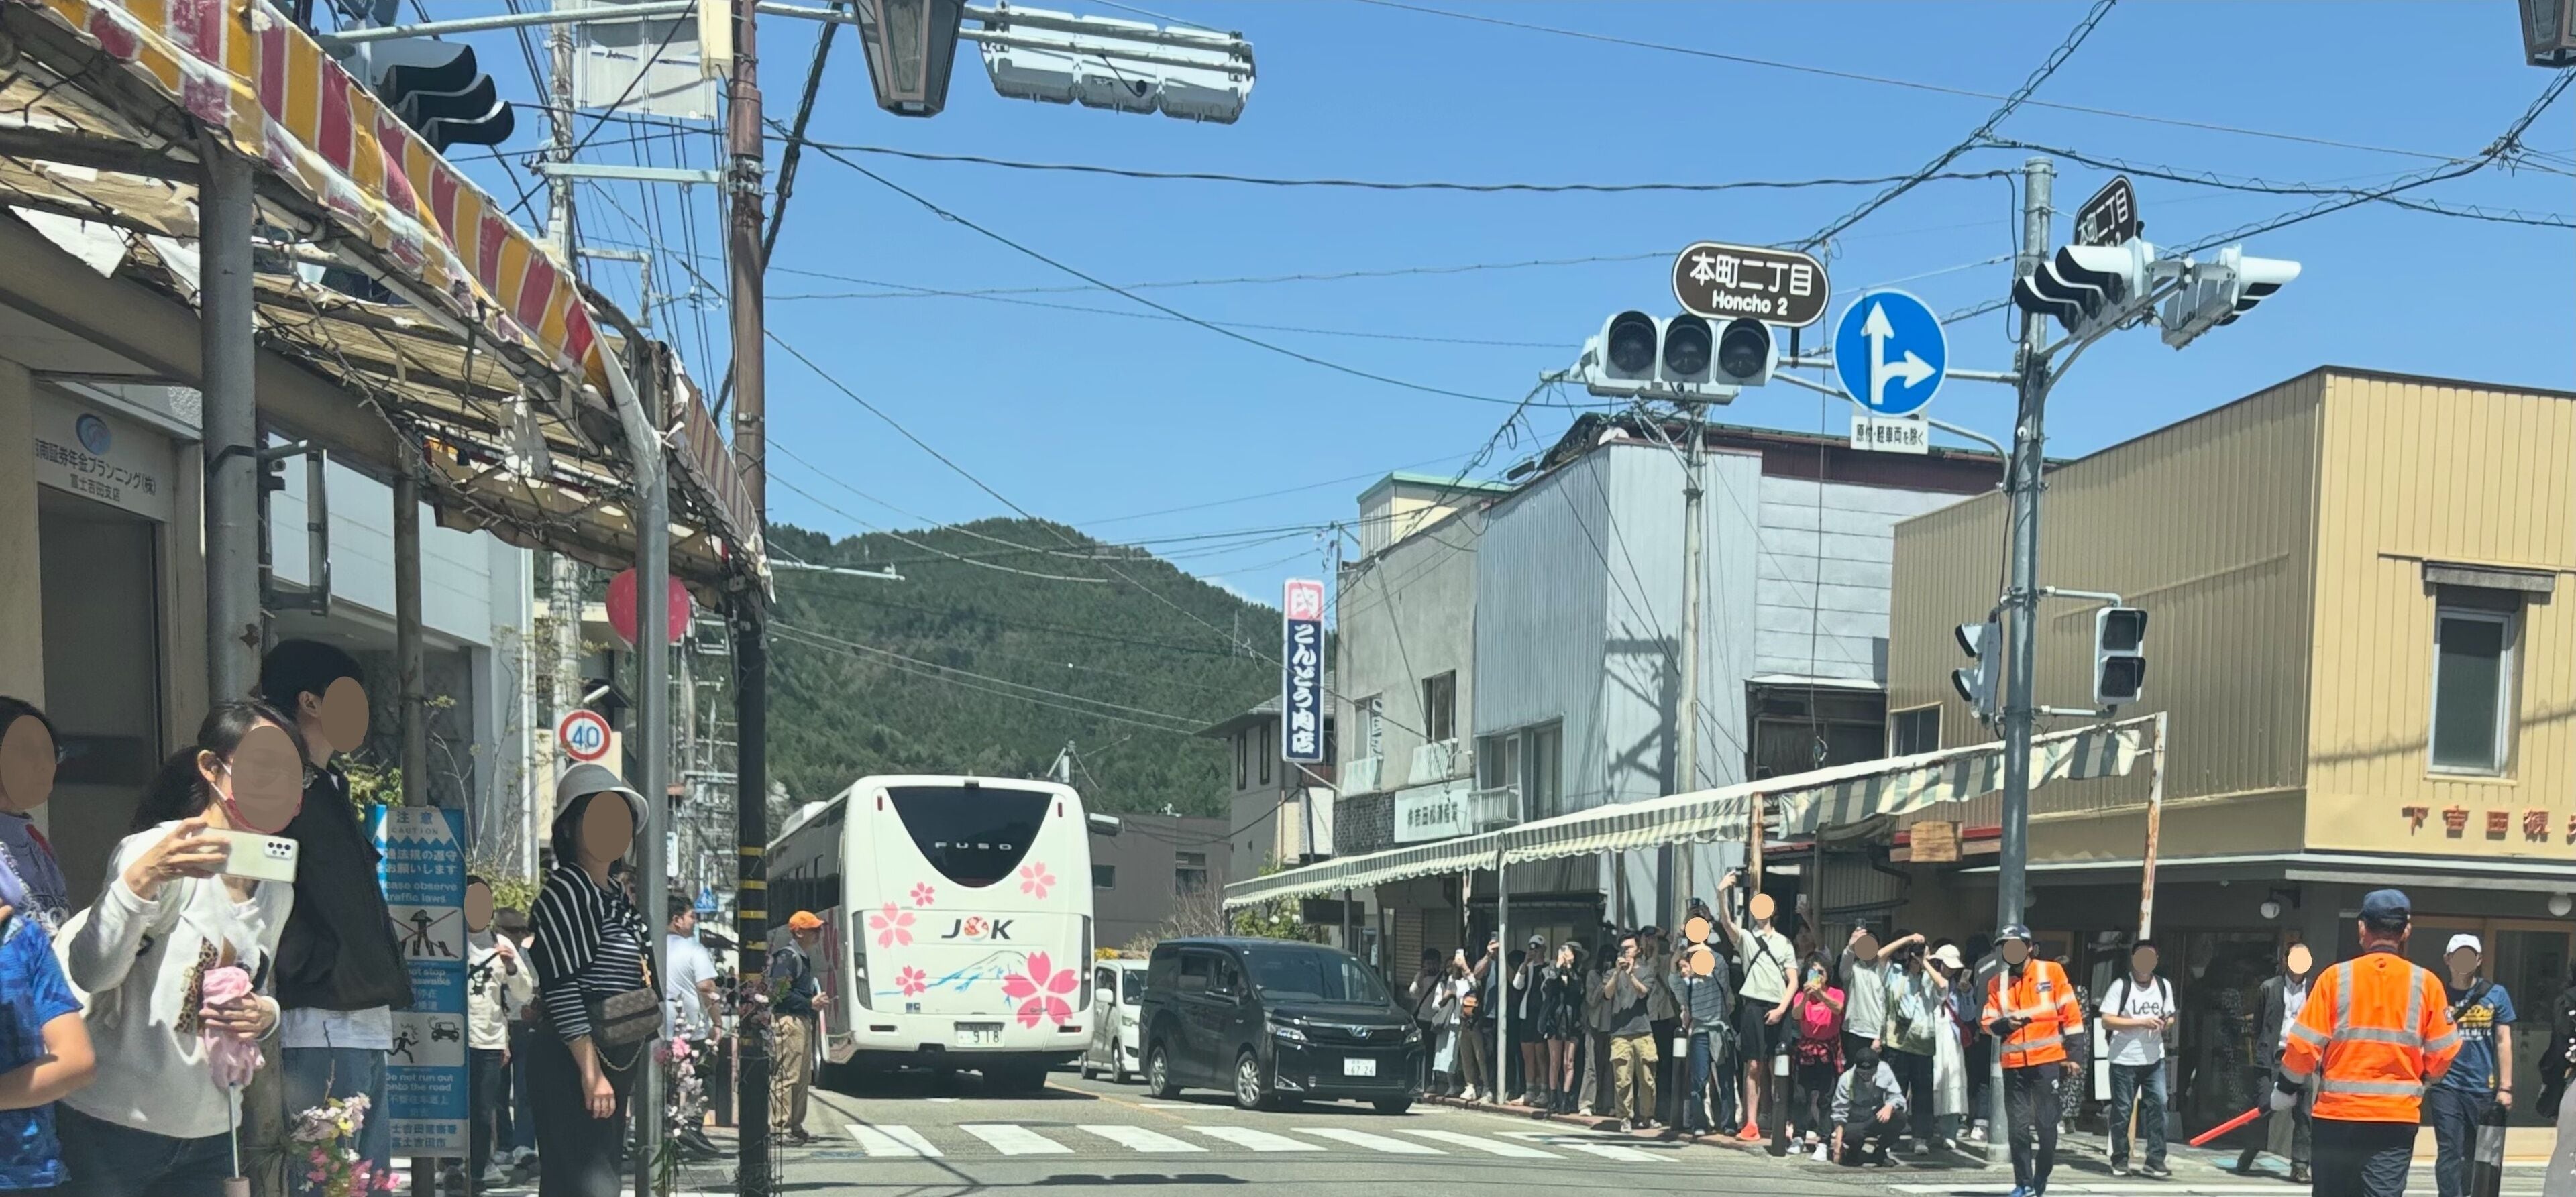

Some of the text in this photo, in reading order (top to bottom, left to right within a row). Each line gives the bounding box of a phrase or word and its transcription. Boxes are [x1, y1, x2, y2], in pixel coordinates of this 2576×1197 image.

[1690, 251, 1811, 296] 本町二丁目
[1712, 289, 1788, 315] Honcho 2
[70, 473, 120, 502] 富士吉田支店
[1291, 587, 1320, 618] 肉
[1292, 624, 1316, 754] こんどう肉店
[571, 725, 600, 748] 40
[386, 892, 446, 903] traffic laws
[2132, 999, 2159, 1015] Lee
[410, 1083, 426, 1092] the
[429, 1084, 451, 1092] road
